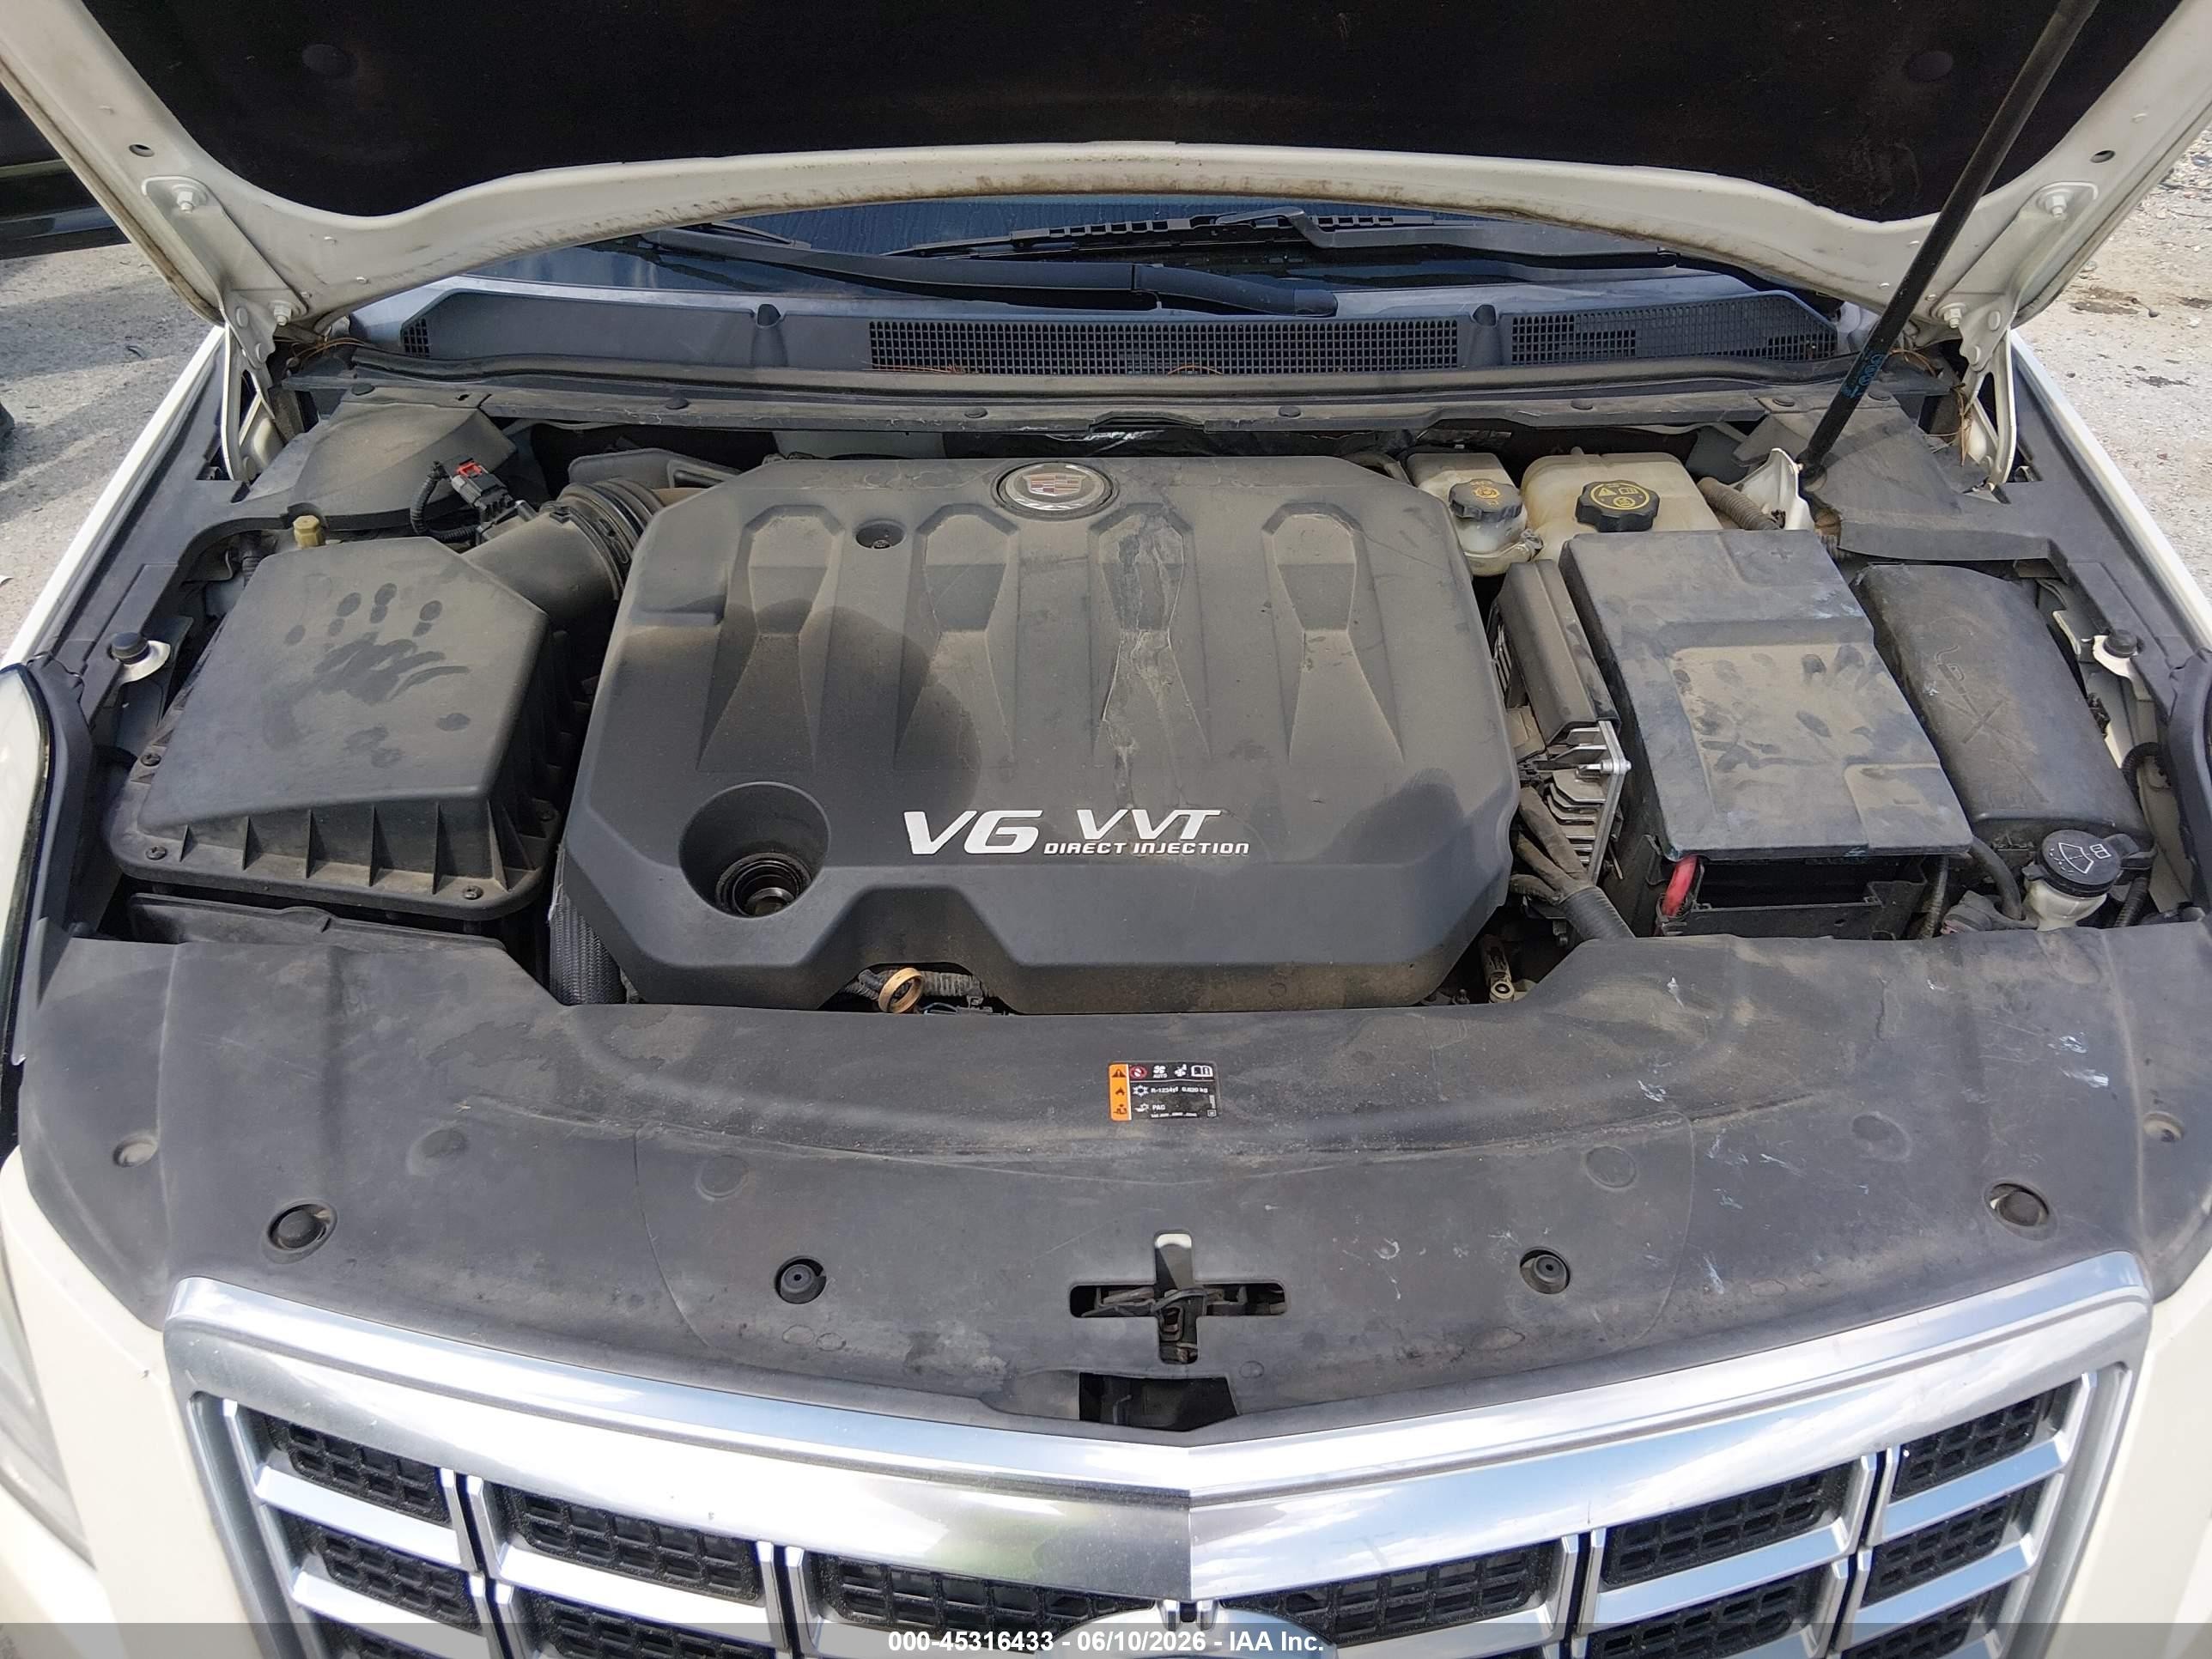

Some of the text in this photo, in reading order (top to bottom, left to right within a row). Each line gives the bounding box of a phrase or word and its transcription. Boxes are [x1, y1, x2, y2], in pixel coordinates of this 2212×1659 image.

[903, 809, 1222, 855] V6 VVT
[1043, 842, 1250, 855] DIRECT INJECTION
